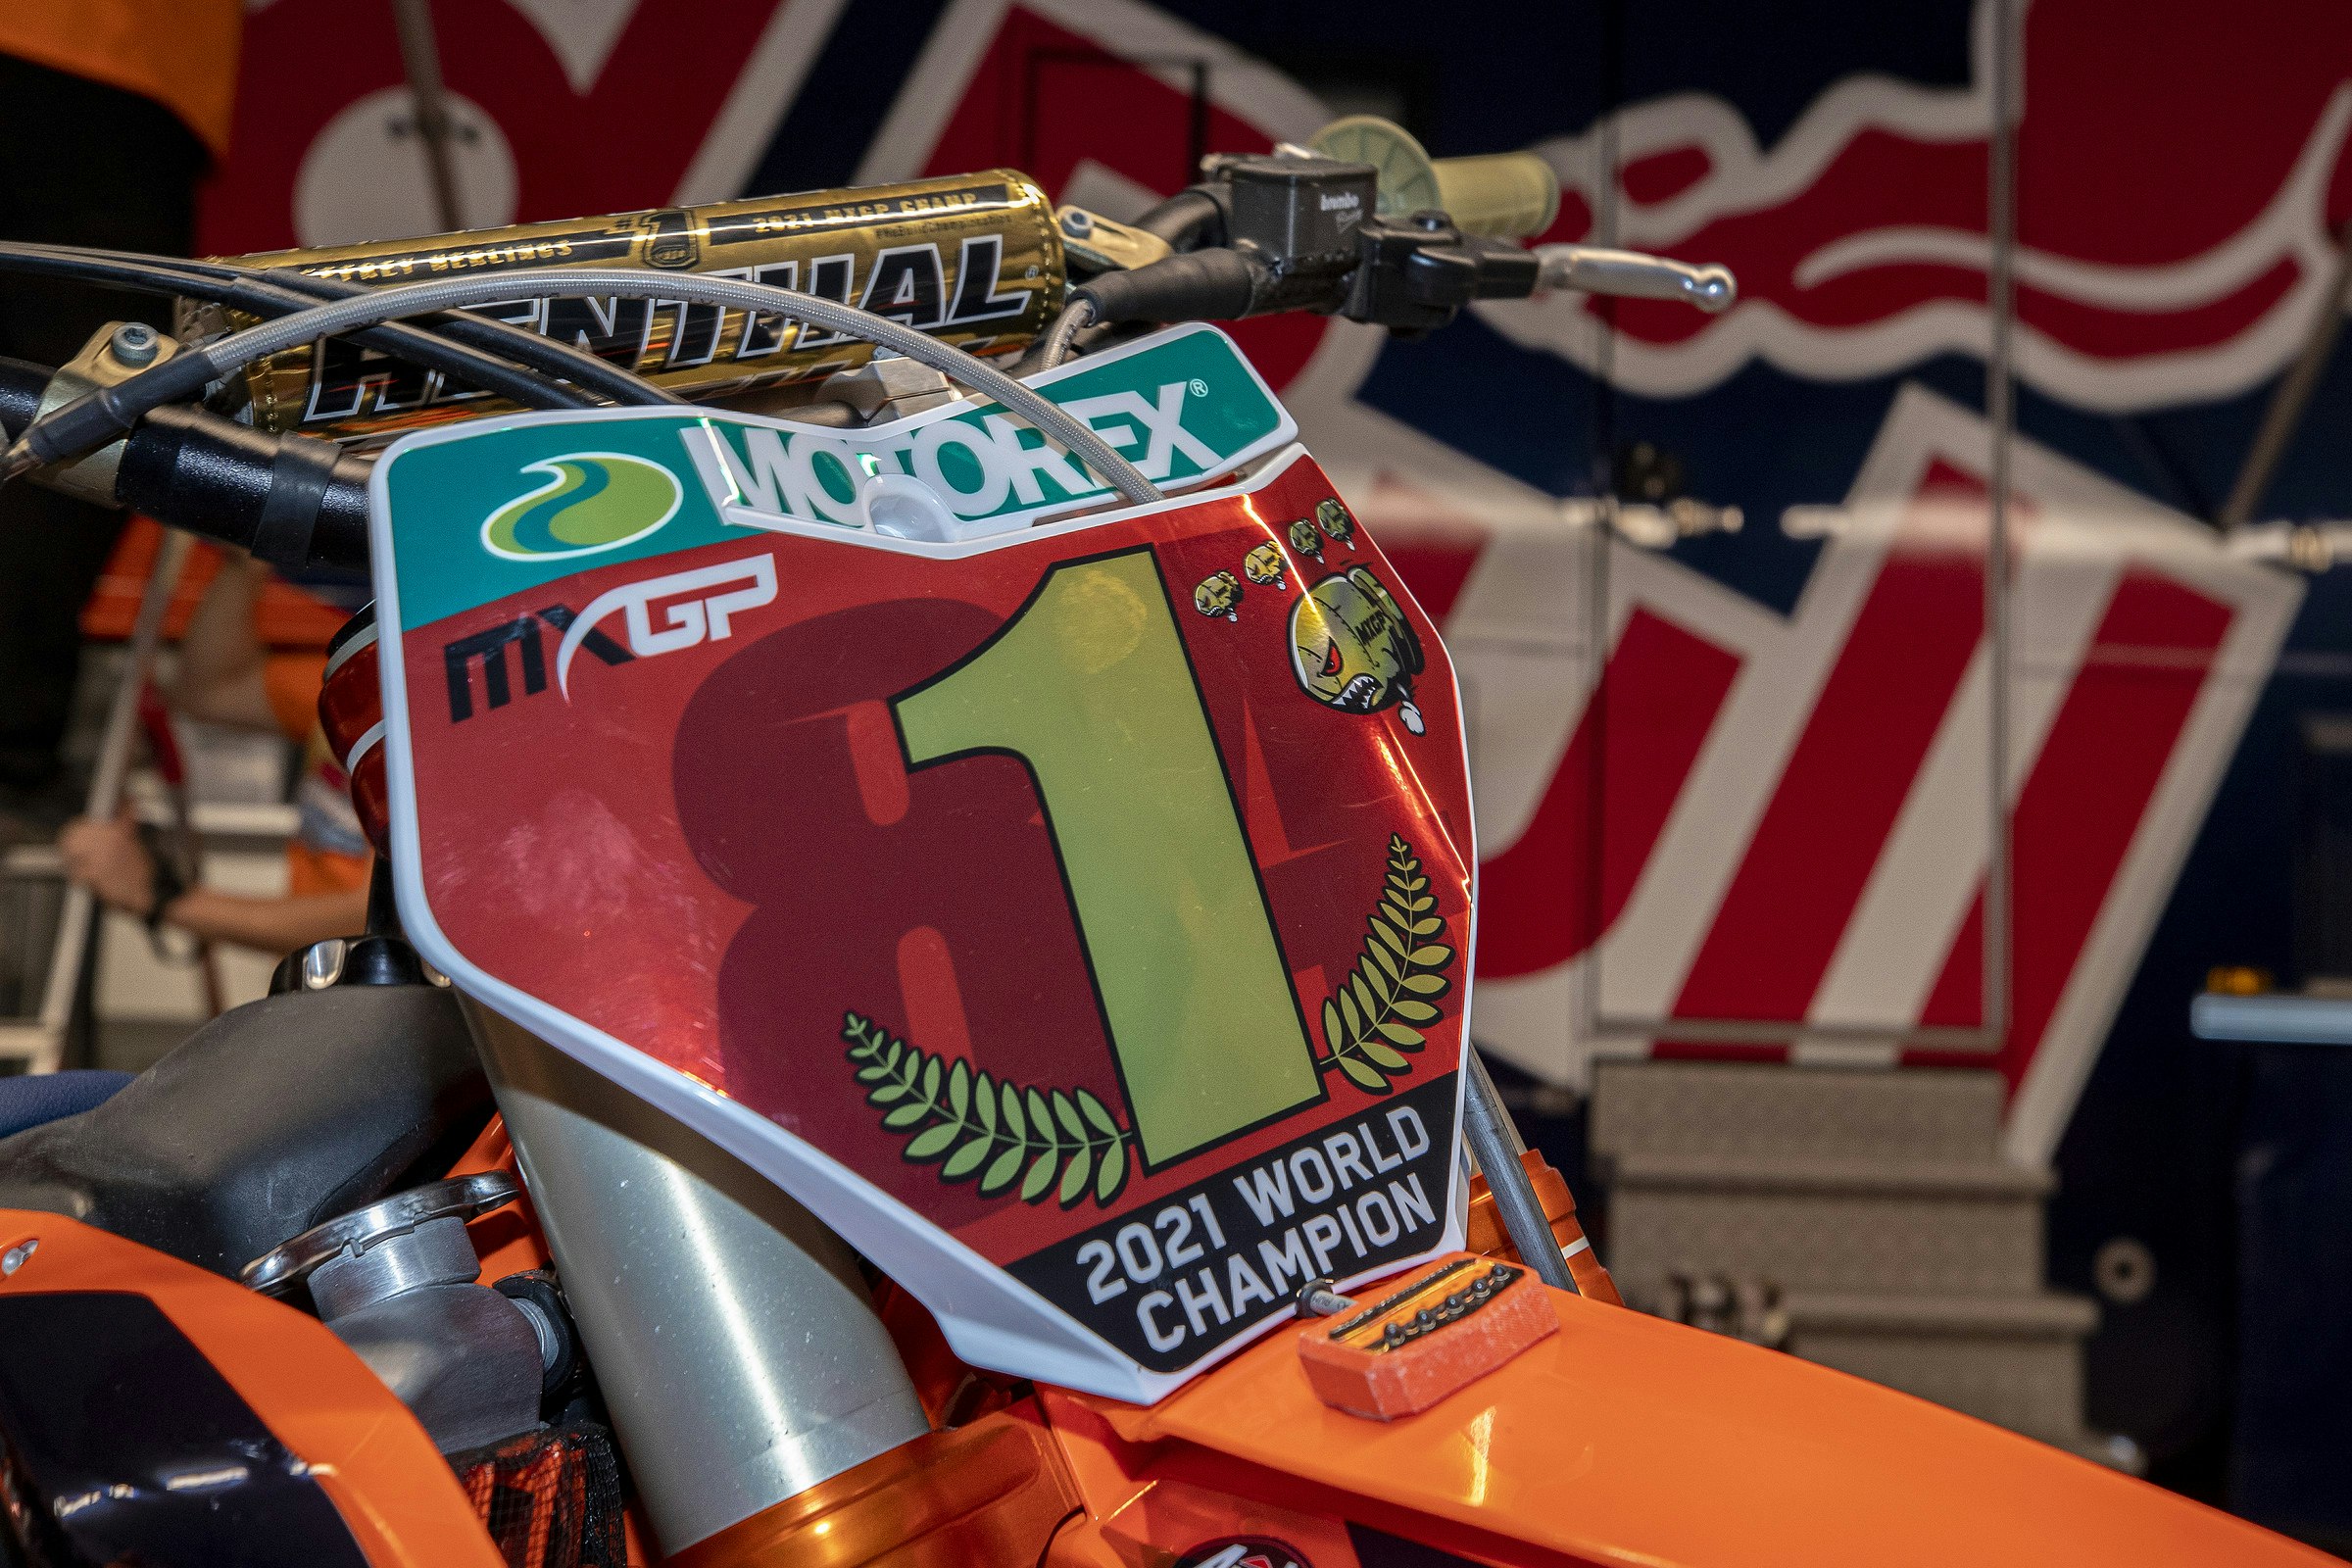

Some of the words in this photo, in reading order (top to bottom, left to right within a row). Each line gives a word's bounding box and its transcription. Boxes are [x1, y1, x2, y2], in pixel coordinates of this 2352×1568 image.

[299, 257, 414, 282] FFREY
[752, 215, 815, 233] 2021
[822, 202, 890, 225] MXGP
[899, 191, 978, 216] CHAMP
[443, 552, 779, 723] MXGP
[887, 541, 1331, 1179] 1
[1076, 1192, 1227, 1305] 2021
[1233, 1104, 1431, 1227] WORLD
[1136, 1172, 1437, 1353] CHAMPION
